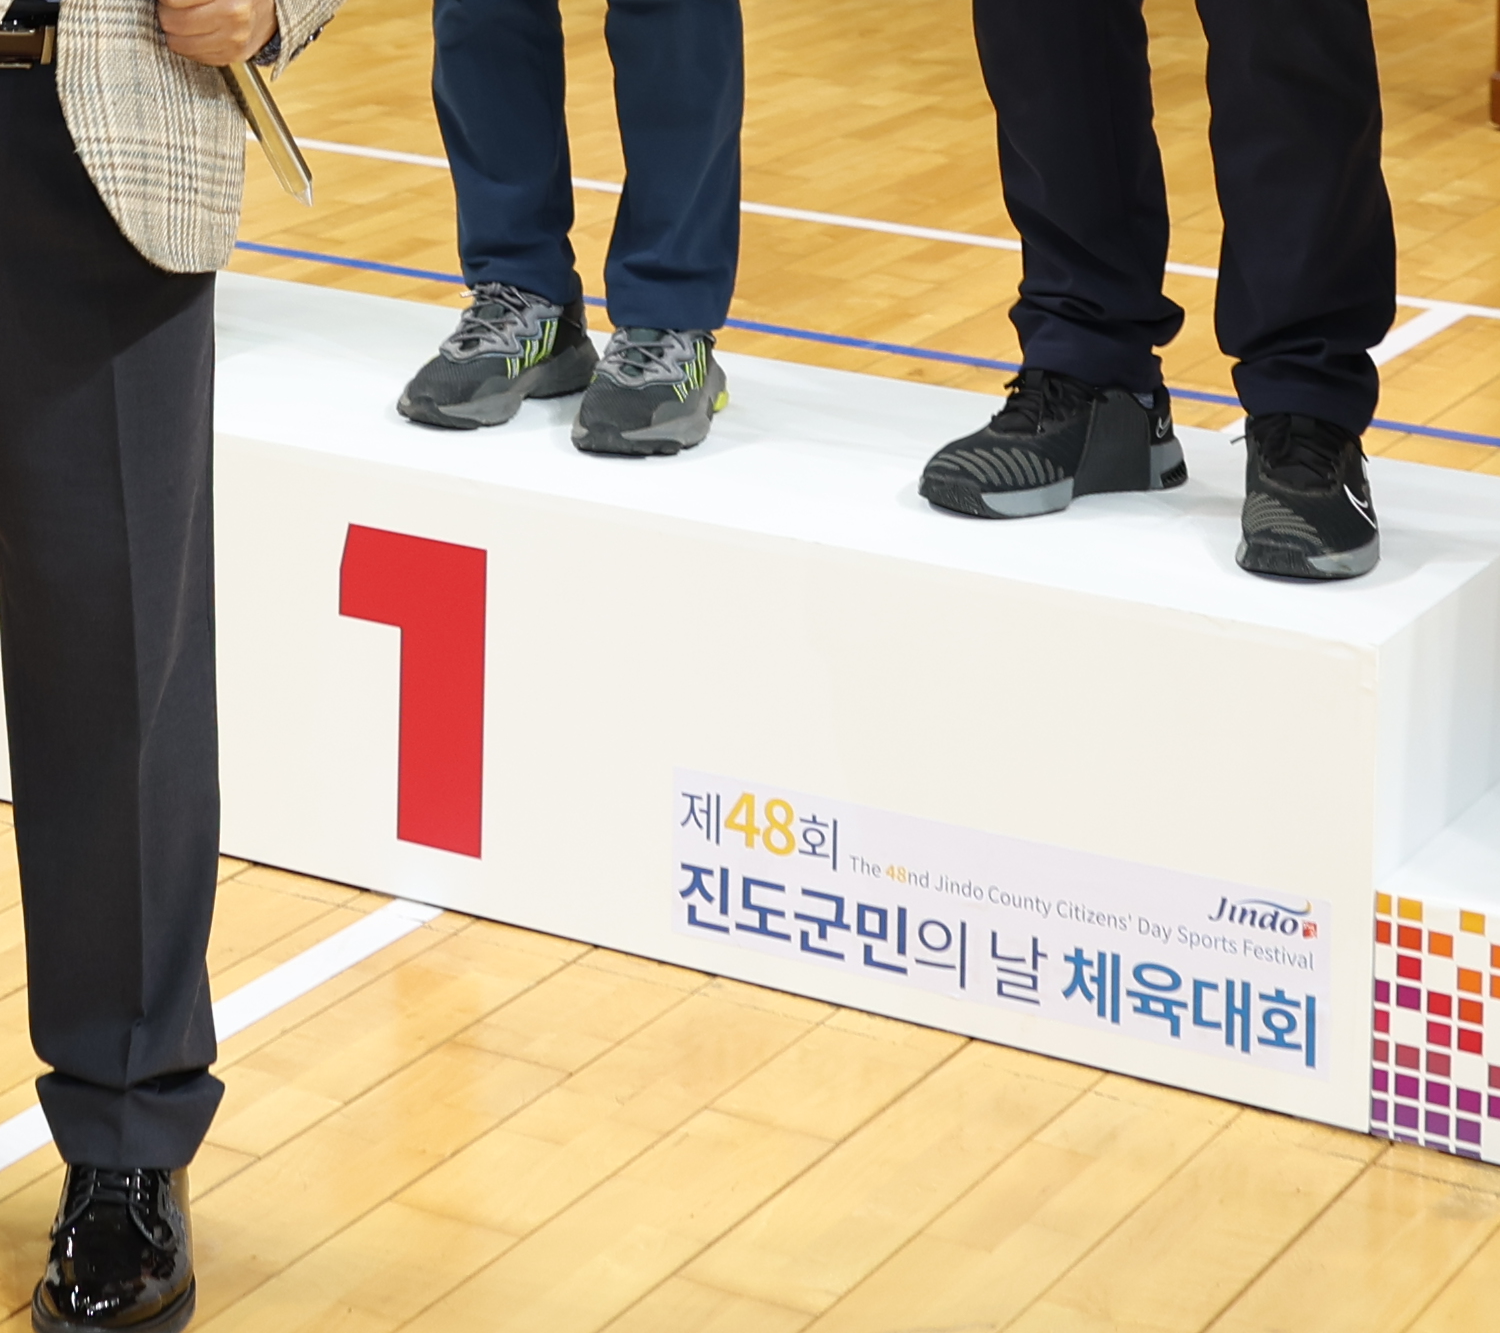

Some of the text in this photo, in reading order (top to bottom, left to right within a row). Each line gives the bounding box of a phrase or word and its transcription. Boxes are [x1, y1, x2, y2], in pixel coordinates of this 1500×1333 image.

[337, 521, 488, 860] 1
[680, 790, 839, 872] 제48회
[849, 854, 882, 879] The
[885, 864, 931, 890] 48nd
[935, 874, 985, 902] Jindo
[987, 884, 1051, 919] County
[1137, 915, 1173, 945] Day
[1177, 924, 1238, 956] Sports
[1242, 937, 1316, 972] Festival
[678, 860, 1317, 1070] 진도군민의 날 체육대회
